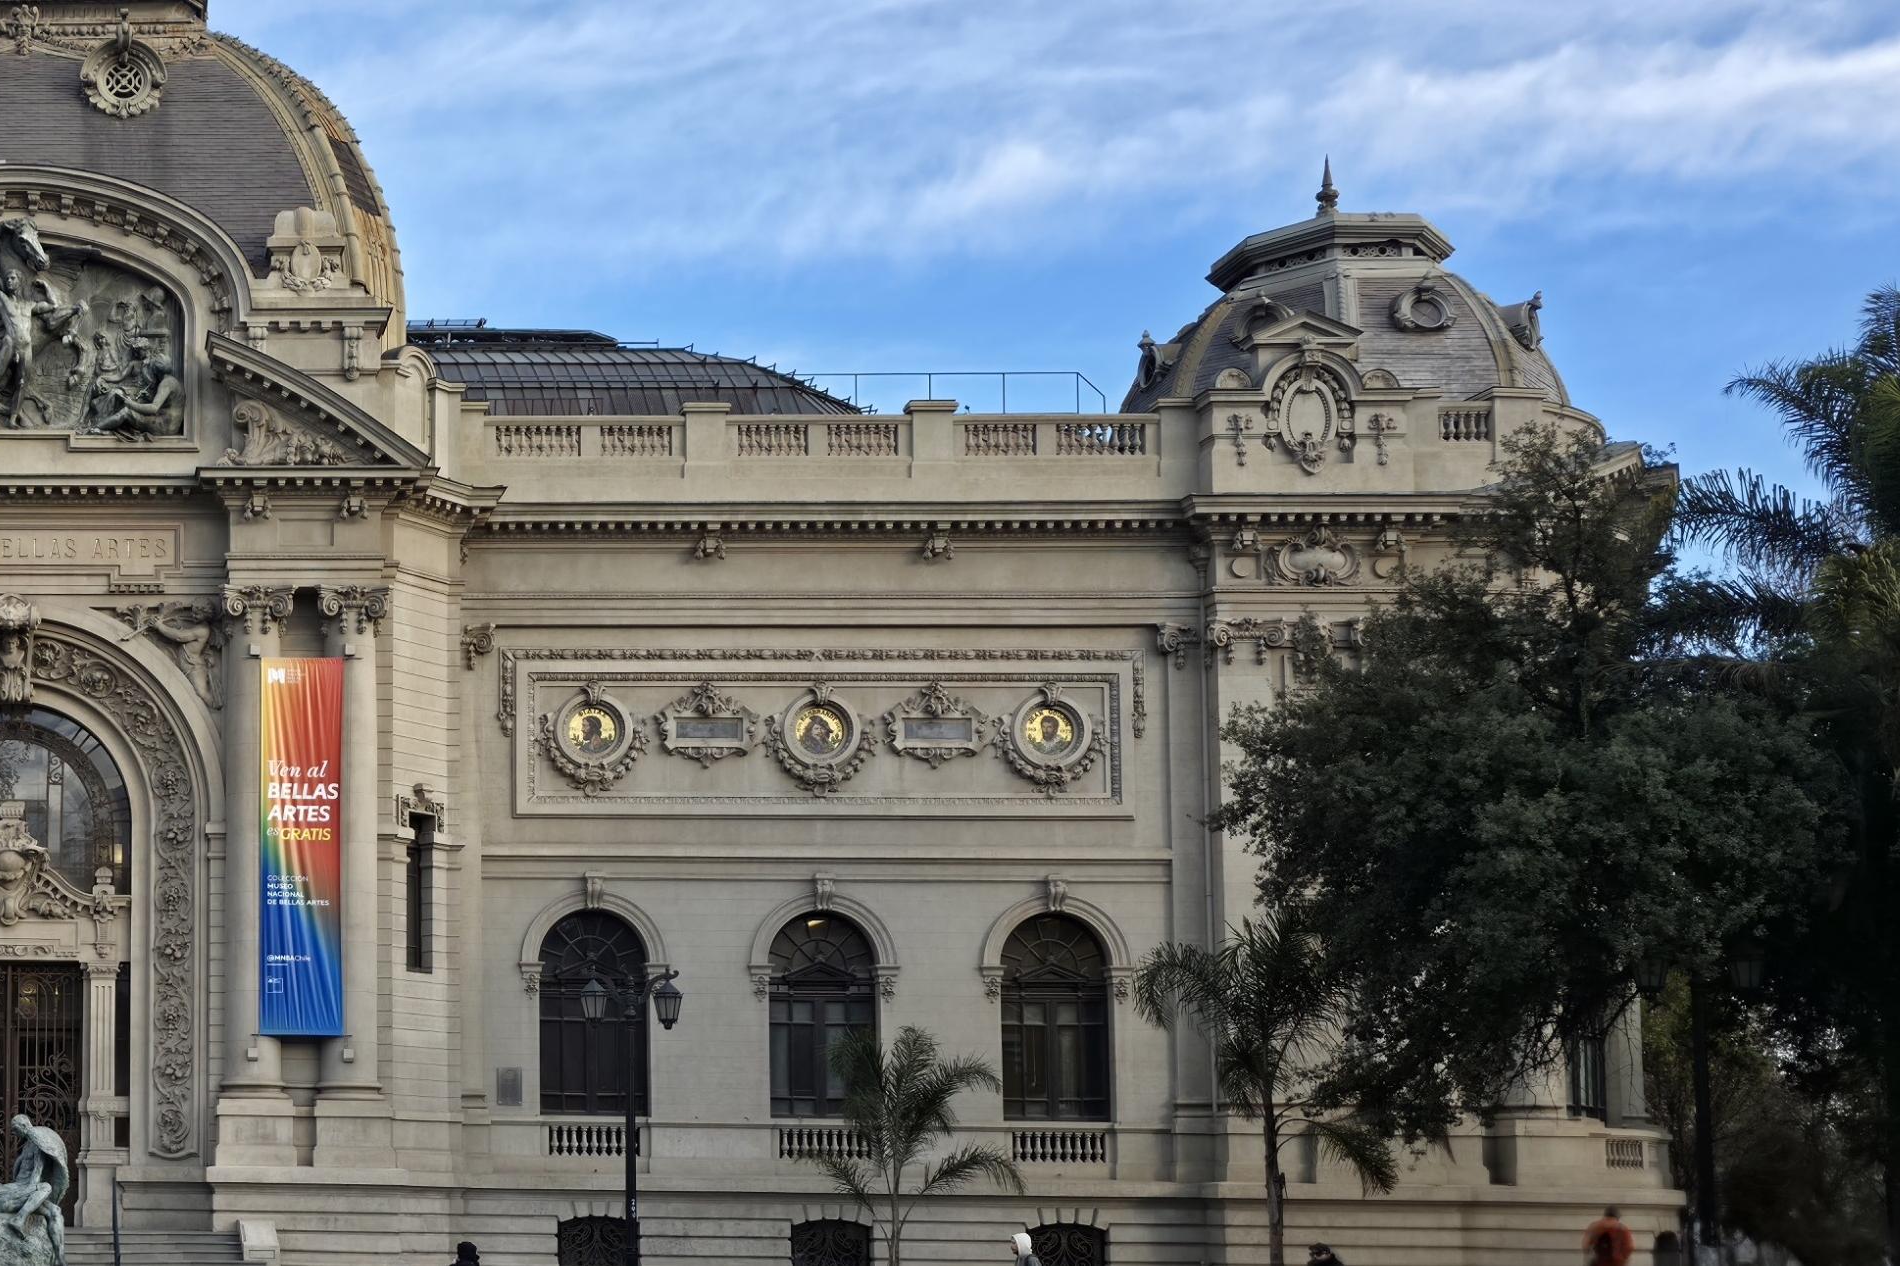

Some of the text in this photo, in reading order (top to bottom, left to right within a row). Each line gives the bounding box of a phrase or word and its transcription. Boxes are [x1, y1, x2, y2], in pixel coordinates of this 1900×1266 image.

[92, 538, 168, 559] ARTES
[268, 759, 329, 778] Ven al
[267, 782, 339, 800] BELLAS
[267, 804, 331, 822] ARTES
[266, 827, 332, 841] es GRATIS
